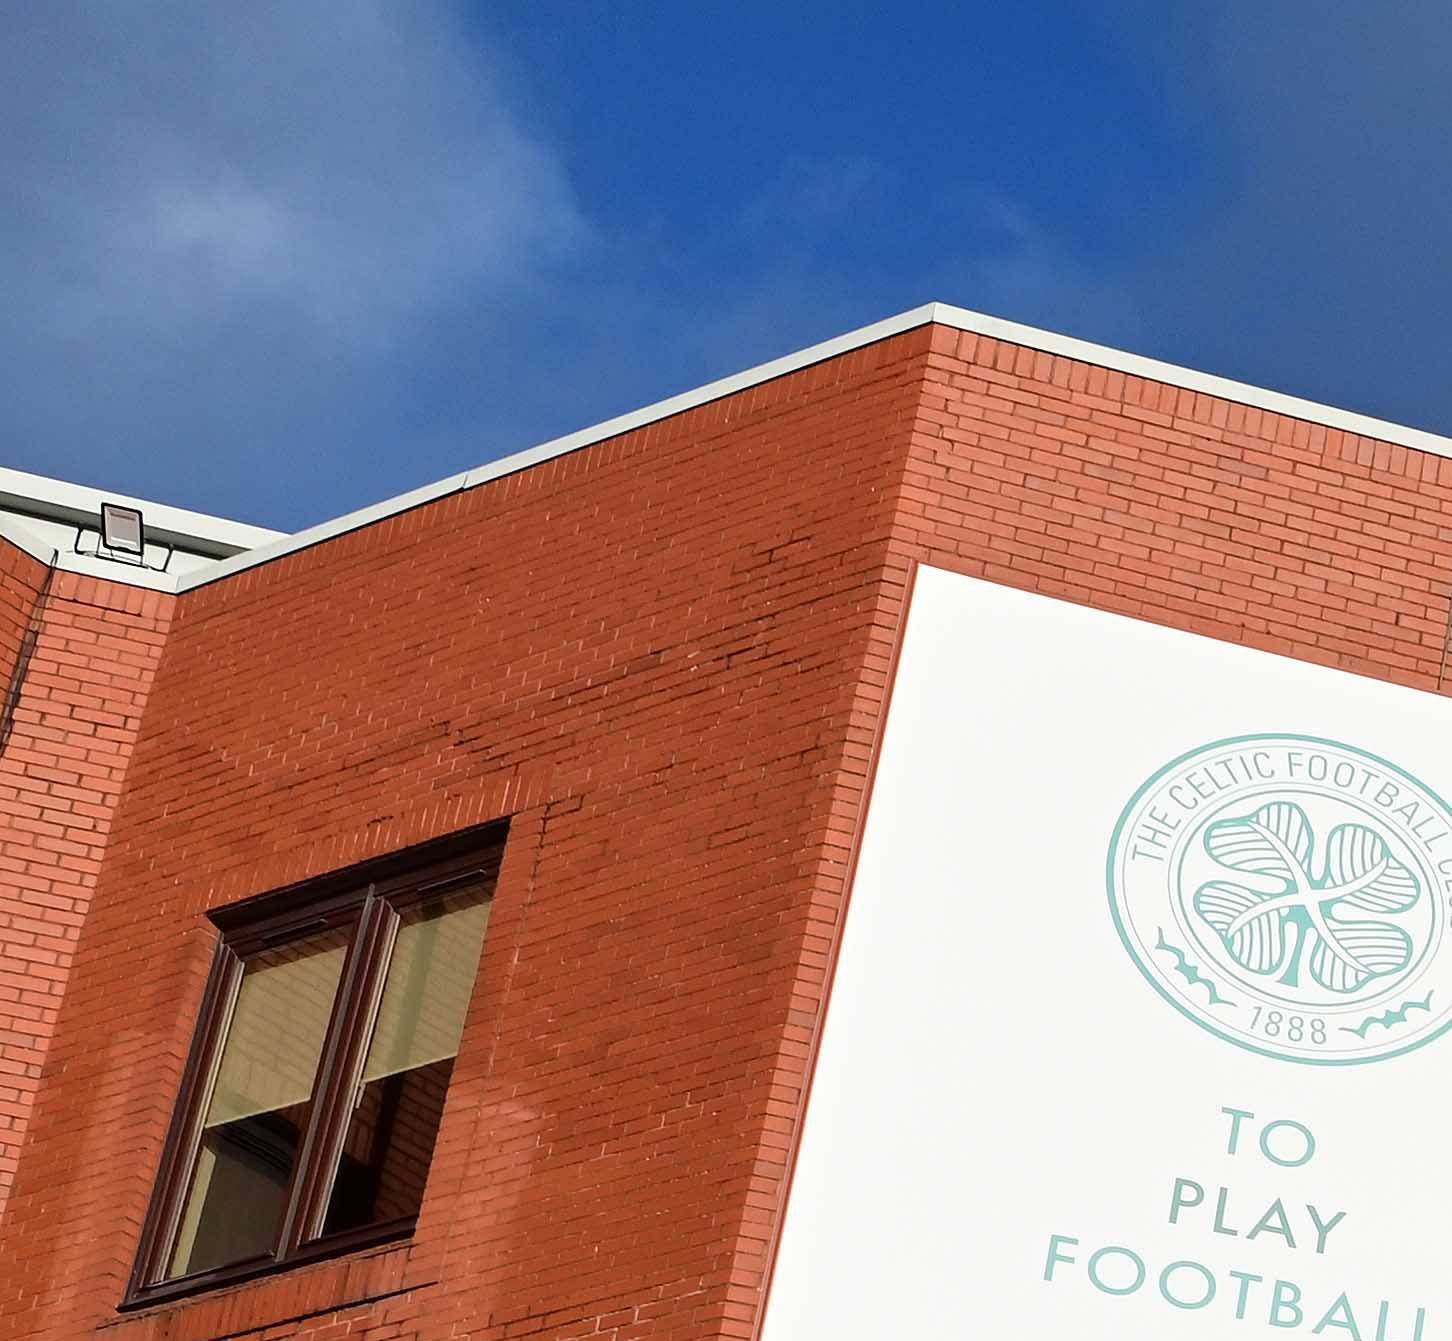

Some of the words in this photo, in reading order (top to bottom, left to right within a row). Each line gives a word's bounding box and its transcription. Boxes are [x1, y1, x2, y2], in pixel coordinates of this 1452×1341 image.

[1132, 806, 1181, 861] THE
[1168, 751, 1275, 811] CELTIC
[1287, 751, 1449, 854] FOOTBALL
[1247, 1003, 1328, 1045] 1888
[1220, 1106, 1317, 1168] TO
[1168, 1177, 1347, 1255] PLAY
